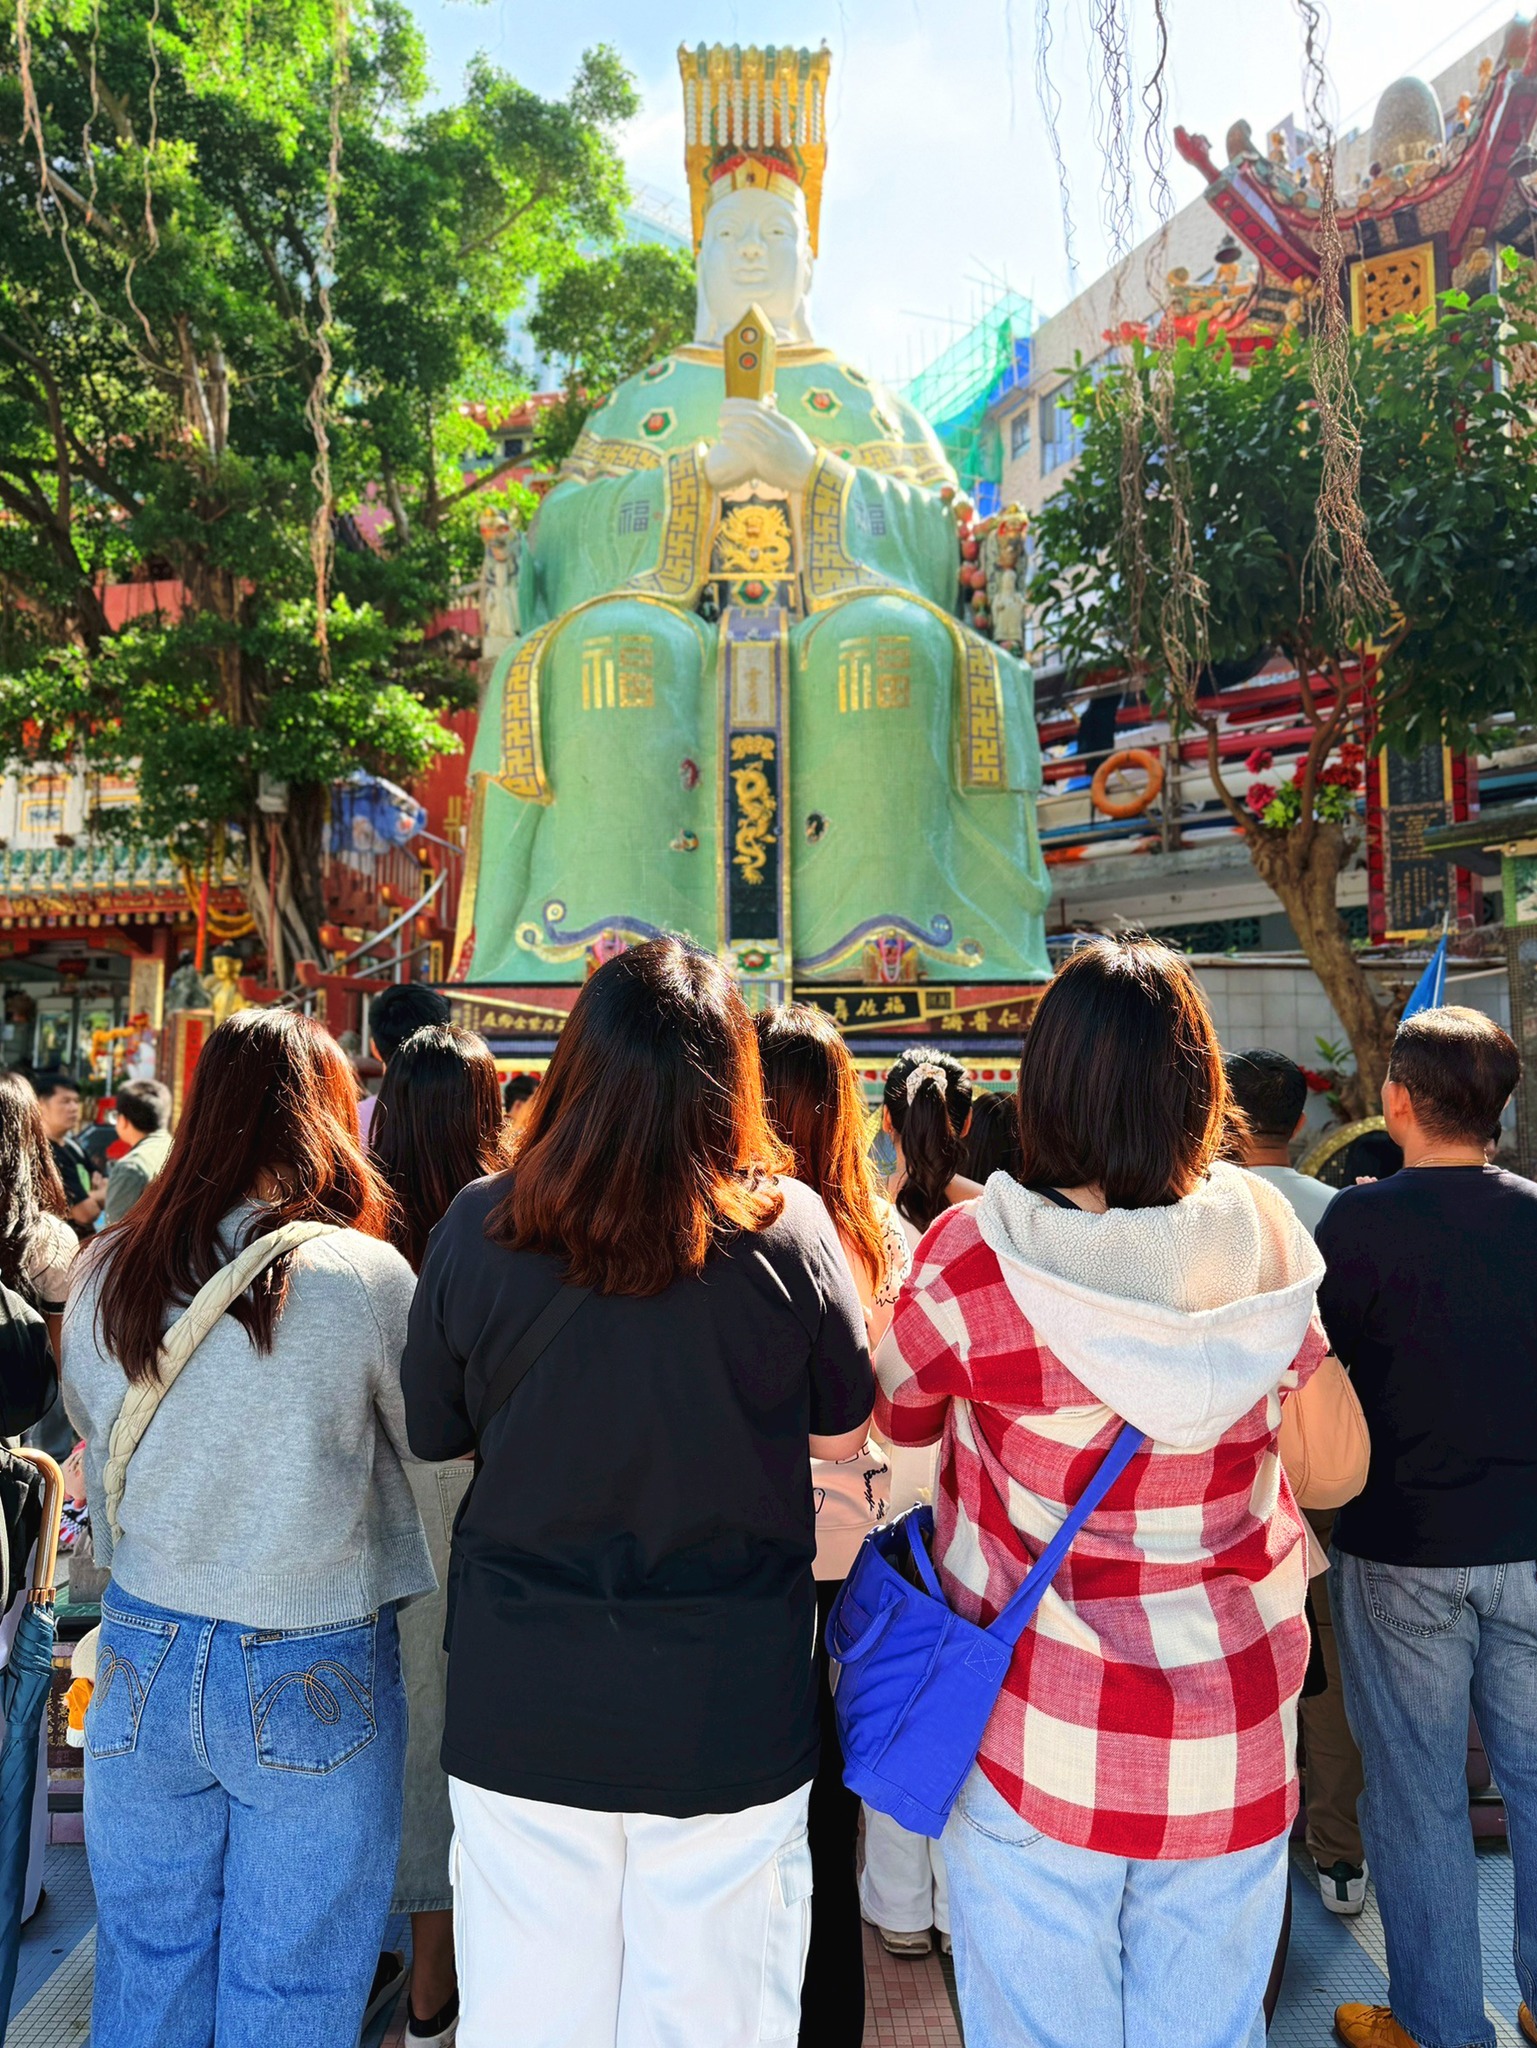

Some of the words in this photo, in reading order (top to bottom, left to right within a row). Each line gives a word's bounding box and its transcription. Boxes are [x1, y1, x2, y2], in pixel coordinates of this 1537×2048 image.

[618, 499, 650, 537] 福
[582, 635, 655, 711] 福
[838, 635, 911, 713] 福
